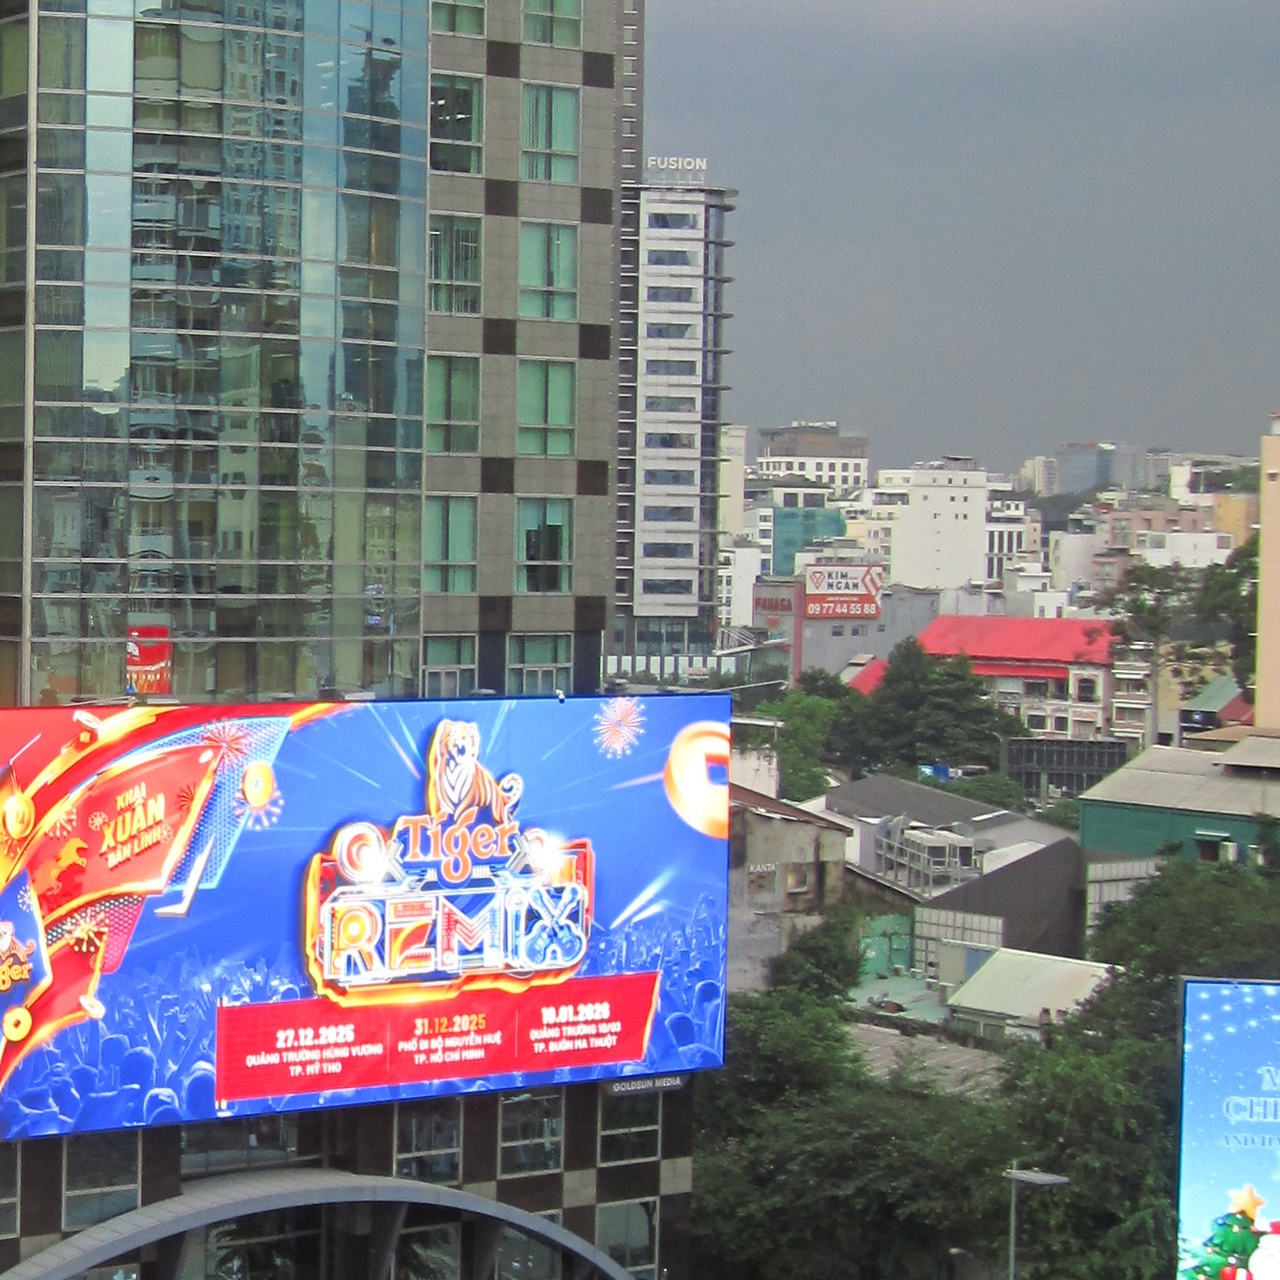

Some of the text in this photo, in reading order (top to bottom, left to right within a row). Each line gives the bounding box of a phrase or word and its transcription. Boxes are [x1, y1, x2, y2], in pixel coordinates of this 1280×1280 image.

[647, 156, 707, 170] FUSION
[827, 571, 849, 580] KIM
[822, 604, 834, 614] 77
[835, 604, 848, 614] 44
[115, 782, 147, 811] KHAI
[100, 794, 166, 854] XUÂN
[402, 807, 520, 884] Tiger
[324, 884, 587, 978] REMIX
[541, 1001, 610, 1025] 10.01.2026
[414, 1013, 487, 1036] 31.12.2025
[276, 1024, 355, 1049] 27.12.2025
[397, 1036, 418, 1052] PHỐ
[483, 1030, 502, 1046] HUỆ
[414, 1052, 429, 1065] TP.
[461, 1047, 486, 1061] MINH
[321, 1062, 343, 1074] THO
[613, 1076, 682, 1092] GOLDSUN MEDIA
